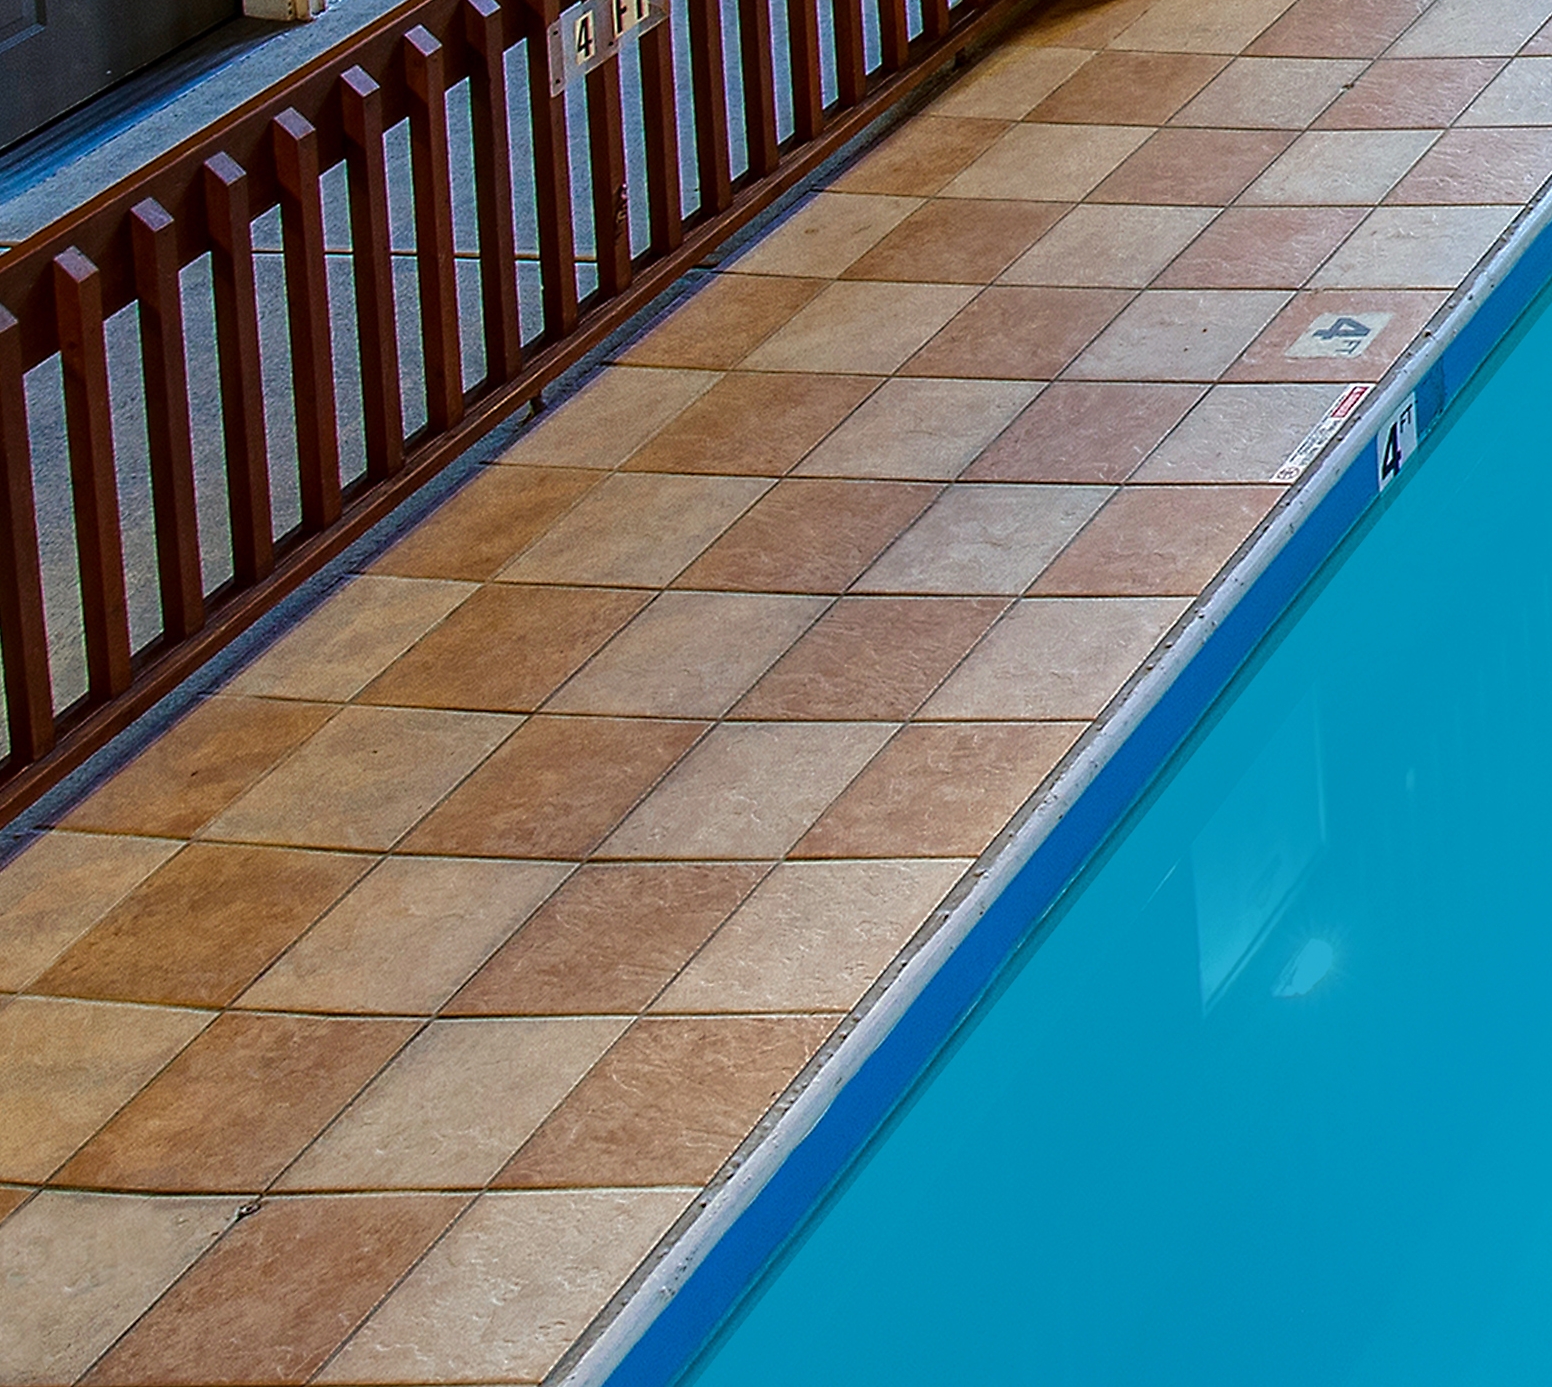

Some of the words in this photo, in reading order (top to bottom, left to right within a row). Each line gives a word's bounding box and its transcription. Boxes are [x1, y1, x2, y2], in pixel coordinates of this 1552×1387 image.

[576, 17, 592, 60] 4
[1312, 317, 1371, 339] 4
[1335, 340, 1361, 354] FT
[1381, 421, 1401, 480] 4
[1400, 403, 1414, 433] FT
